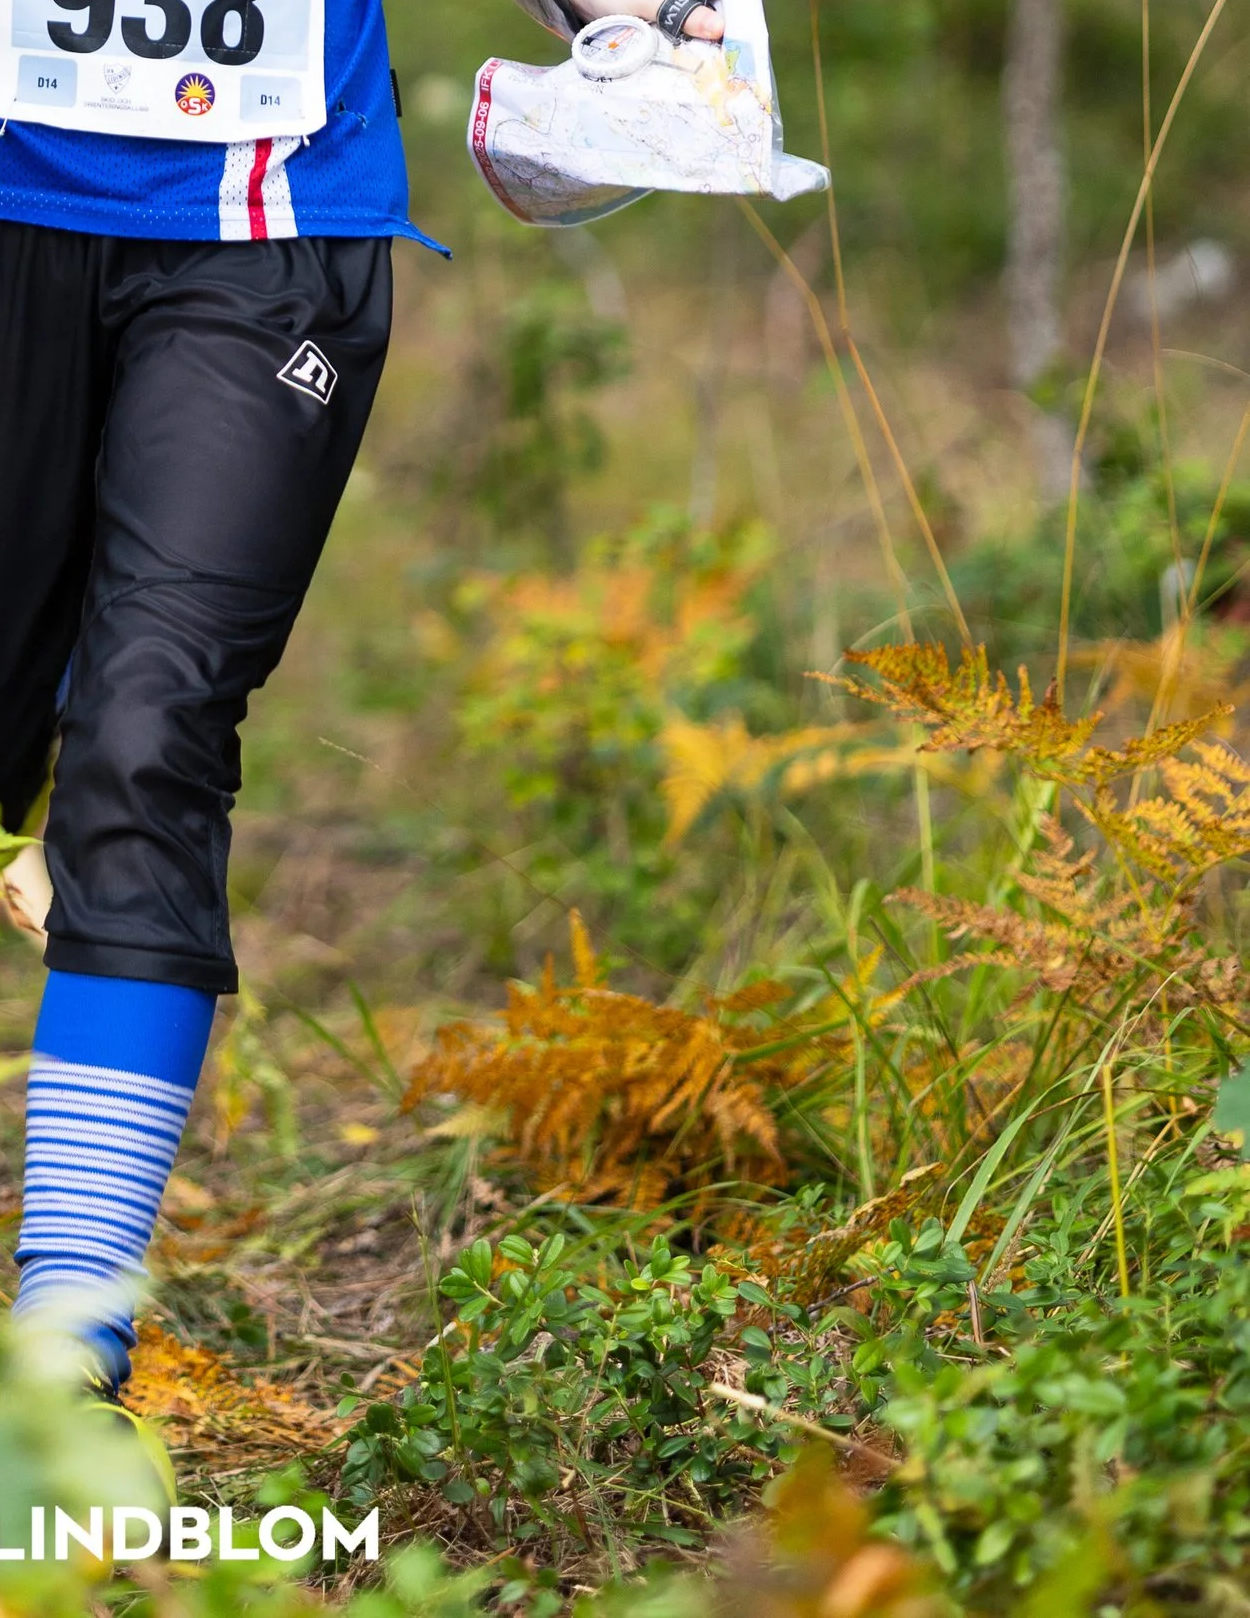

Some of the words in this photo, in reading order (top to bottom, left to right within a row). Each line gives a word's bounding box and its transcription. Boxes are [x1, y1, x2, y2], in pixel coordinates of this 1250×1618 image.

[37, 76, 58, 90] D14
[180, 96, 210, 116] OSK
[260, 94, 281, 106] D14
